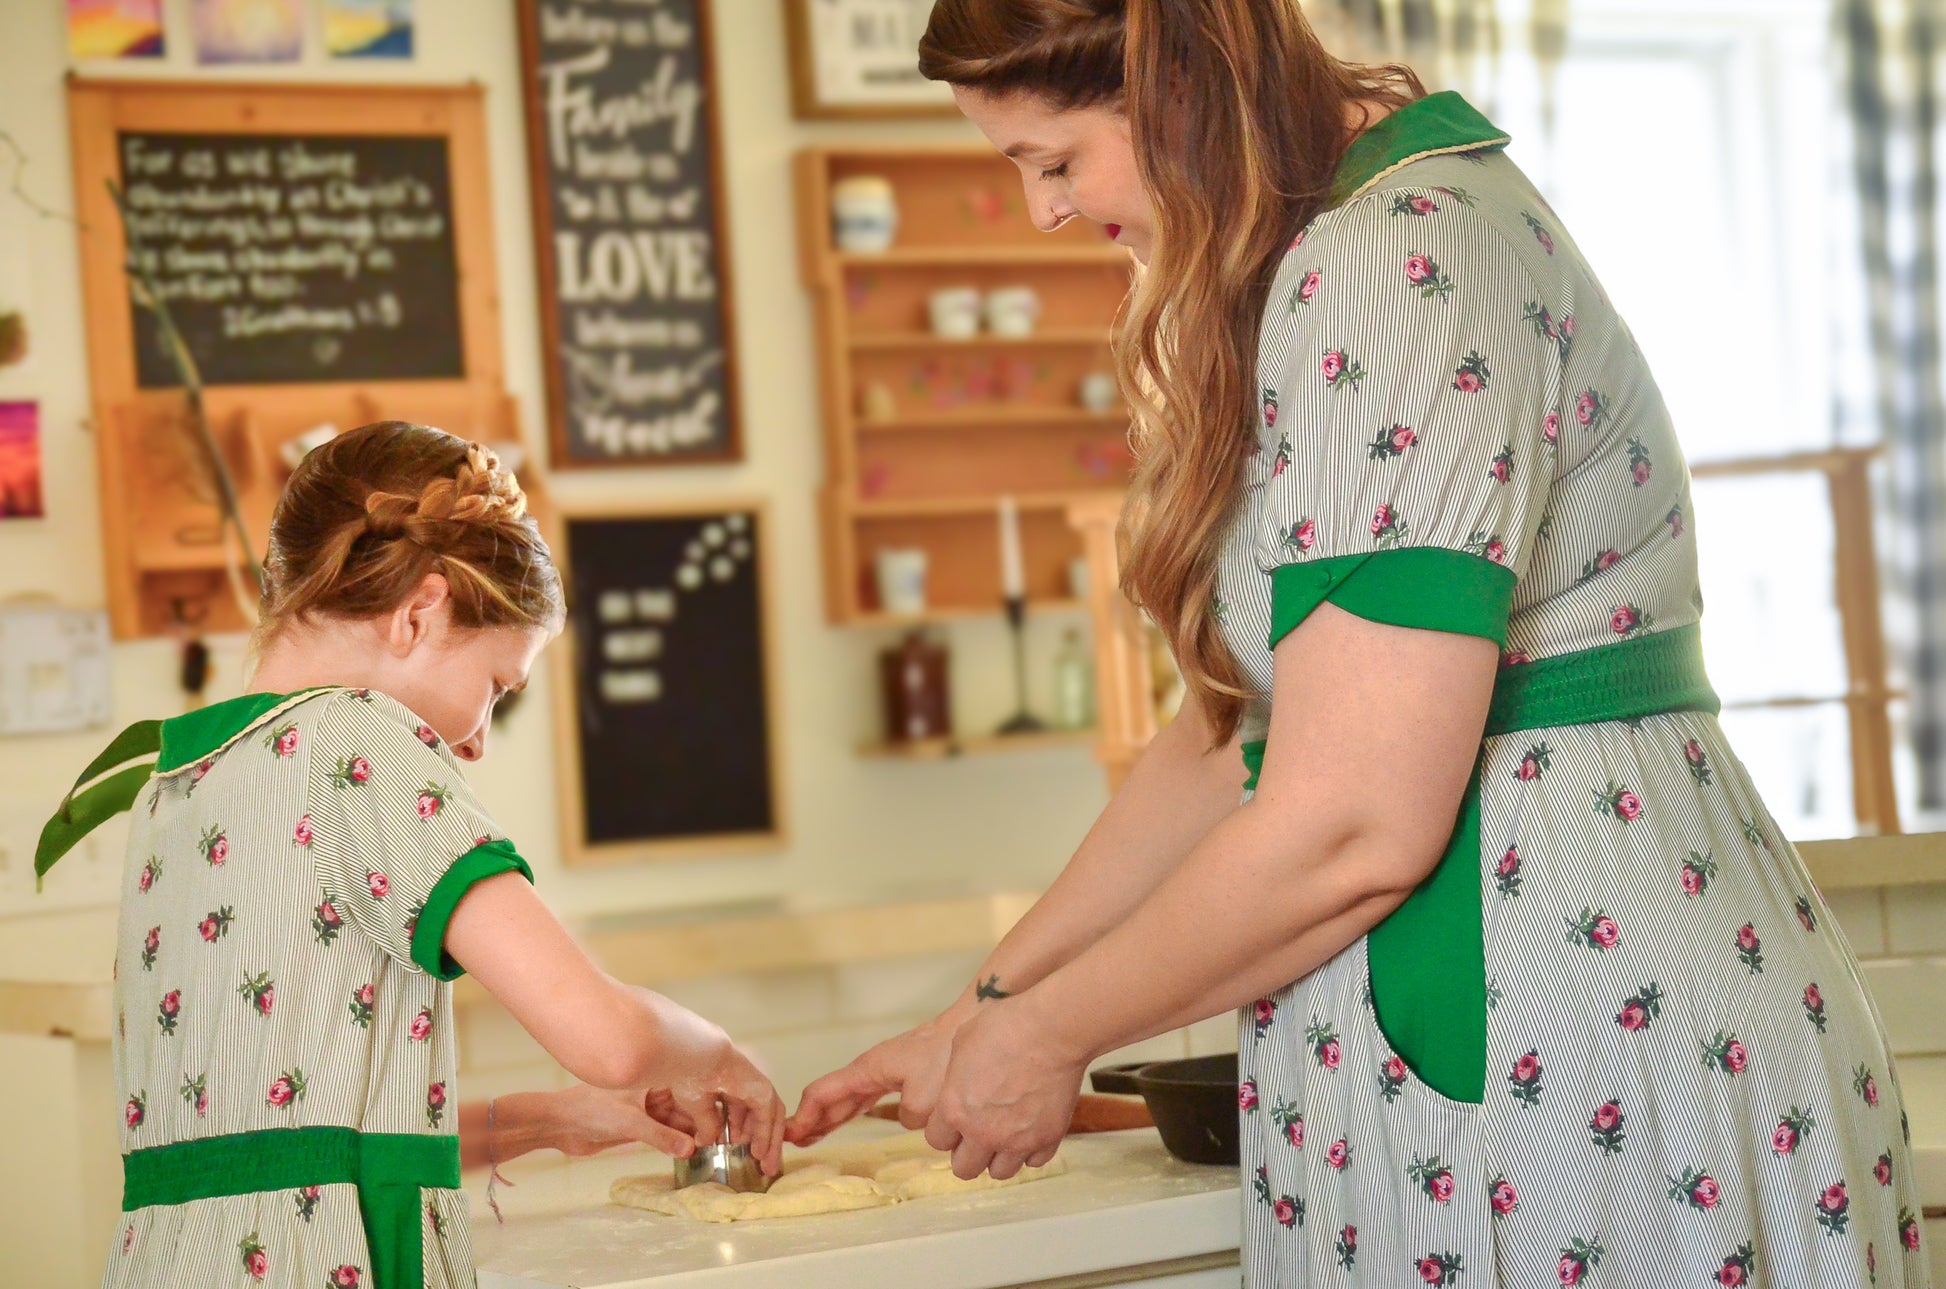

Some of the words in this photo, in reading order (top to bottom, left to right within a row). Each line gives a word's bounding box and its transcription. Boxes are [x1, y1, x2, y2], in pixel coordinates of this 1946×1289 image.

[540, 46, 698, 170] Family
[126, 138, 172, 177] For
[181, 150, 216, 178] as
[226, 150, 270, 178] we
[554, 231, 717, 303] LOVE
